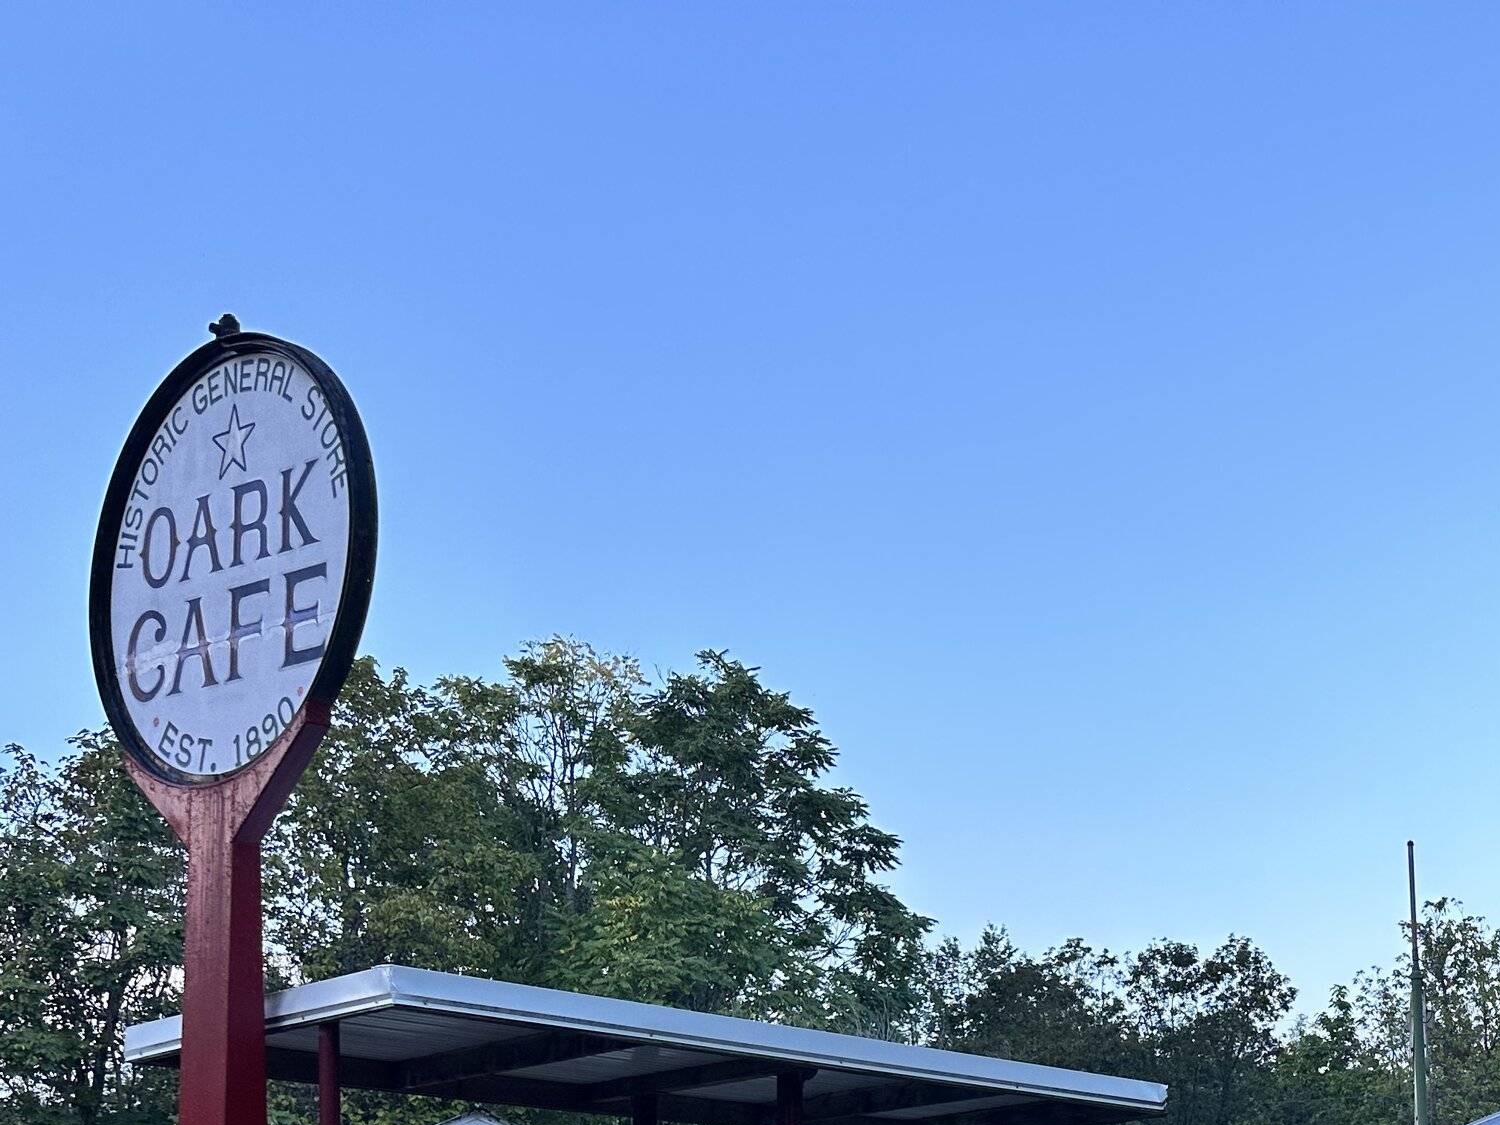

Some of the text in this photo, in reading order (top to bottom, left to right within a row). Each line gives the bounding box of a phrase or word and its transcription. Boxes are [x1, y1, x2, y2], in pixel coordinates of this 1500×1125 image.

[116, 357, 347, 569] HISTORIC GENERAL STORE
[140, 457, 320, 589] OARK
[125, 562, 328, 703] CAFE
[157, 696, 294, 773] EST. 1890
